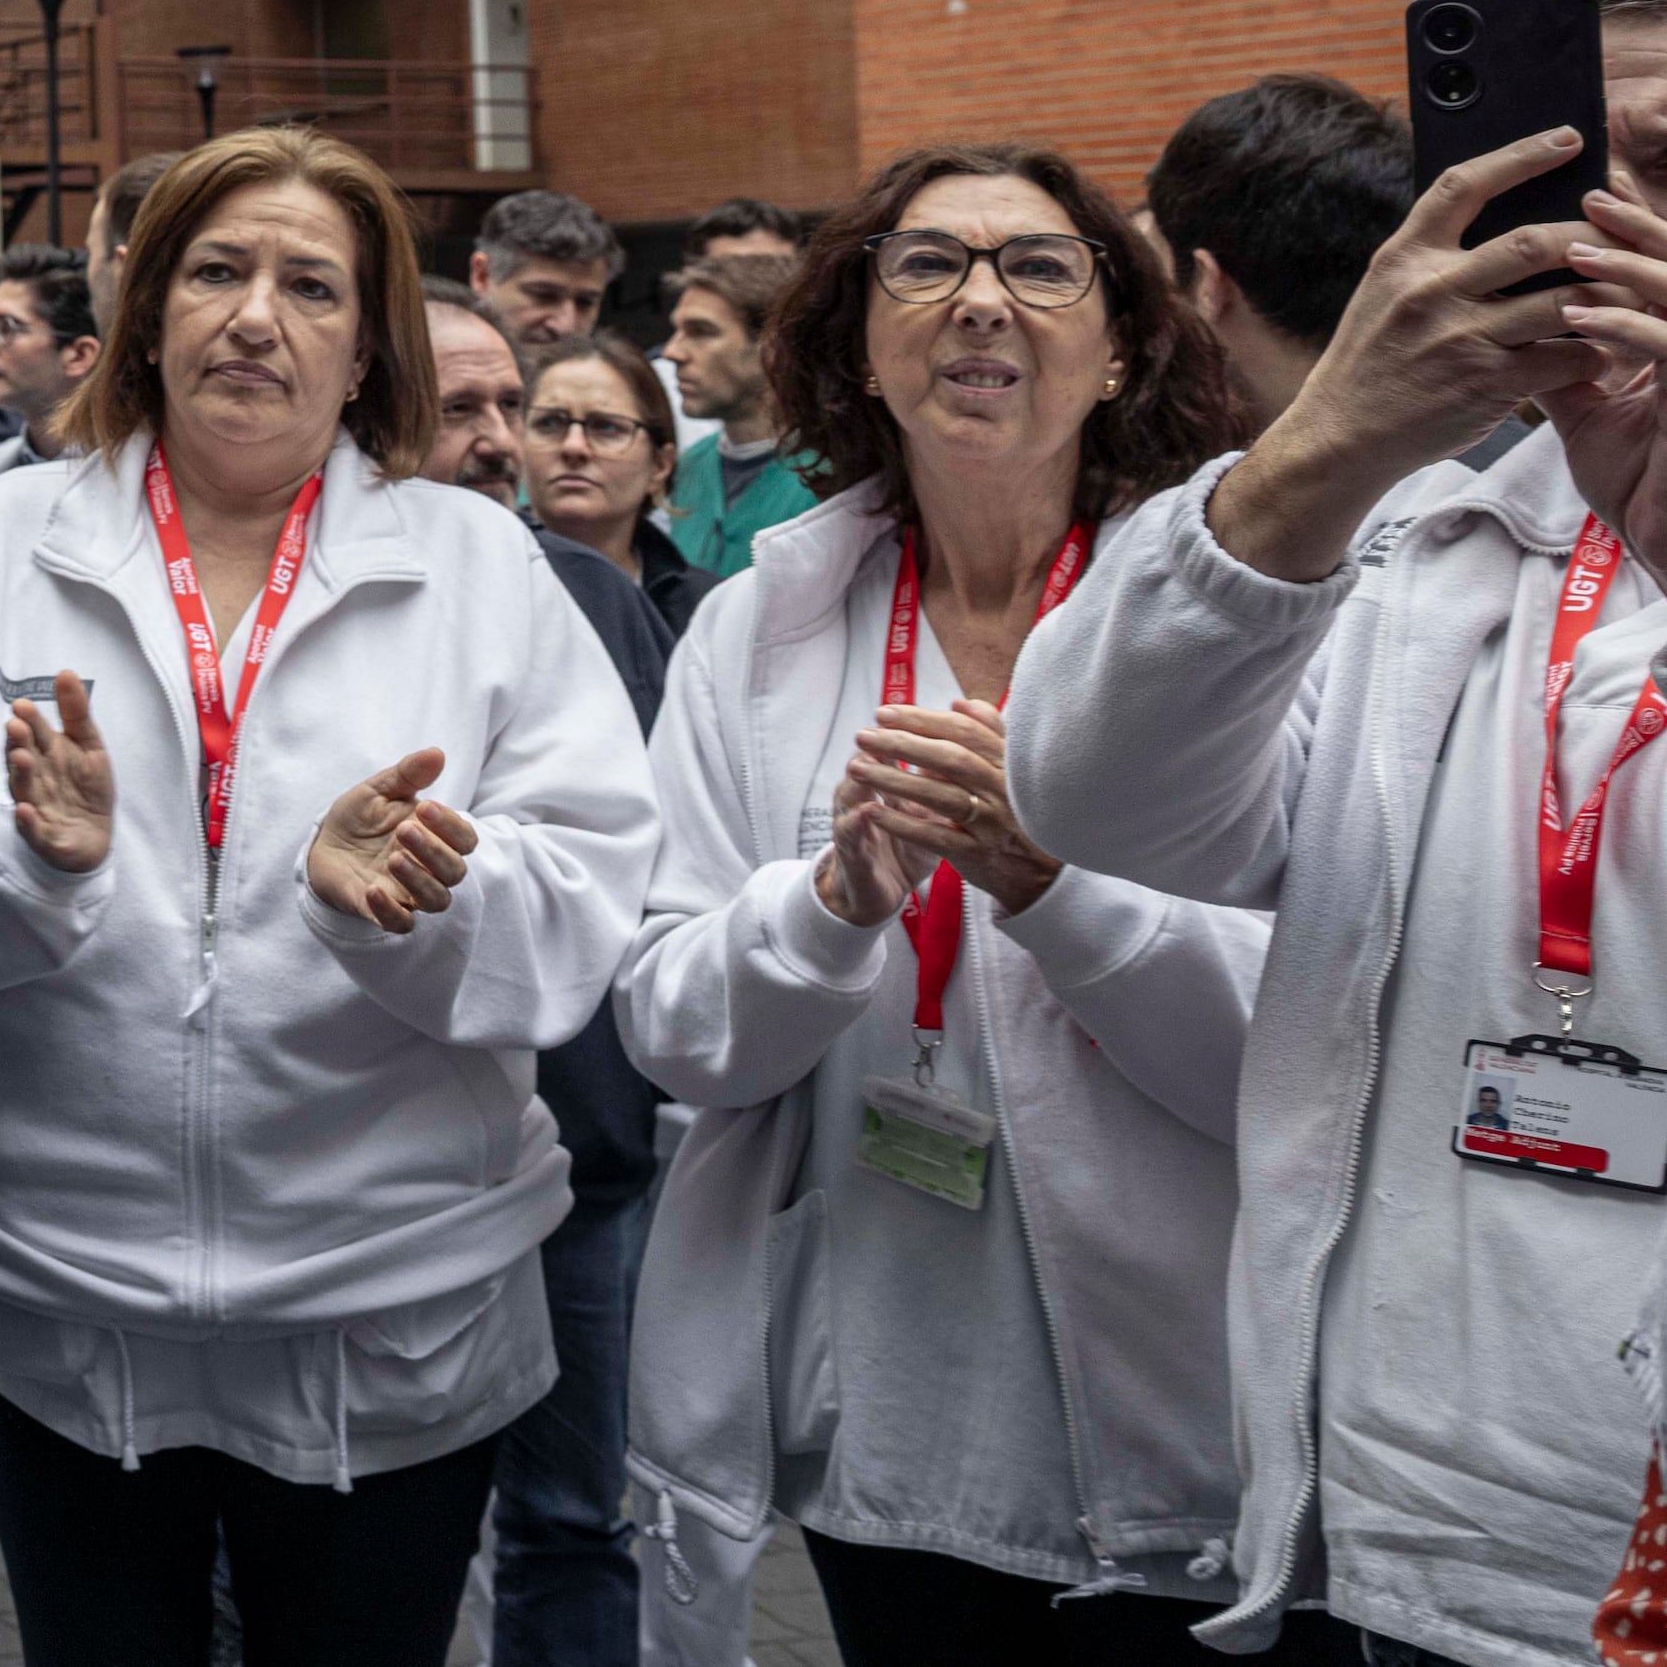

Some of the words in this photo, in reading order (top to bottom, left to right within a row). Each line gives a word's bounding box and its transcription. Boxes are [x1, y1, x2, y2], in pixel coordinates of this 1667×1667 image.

[168, 561, 187, 596] Valor
[269, 556, 296, 596] UGT
[1563, 565, 1604, 612] UGT
[187, 622, 213, 653] UGT
[890, 623, 910, 654] UGT
